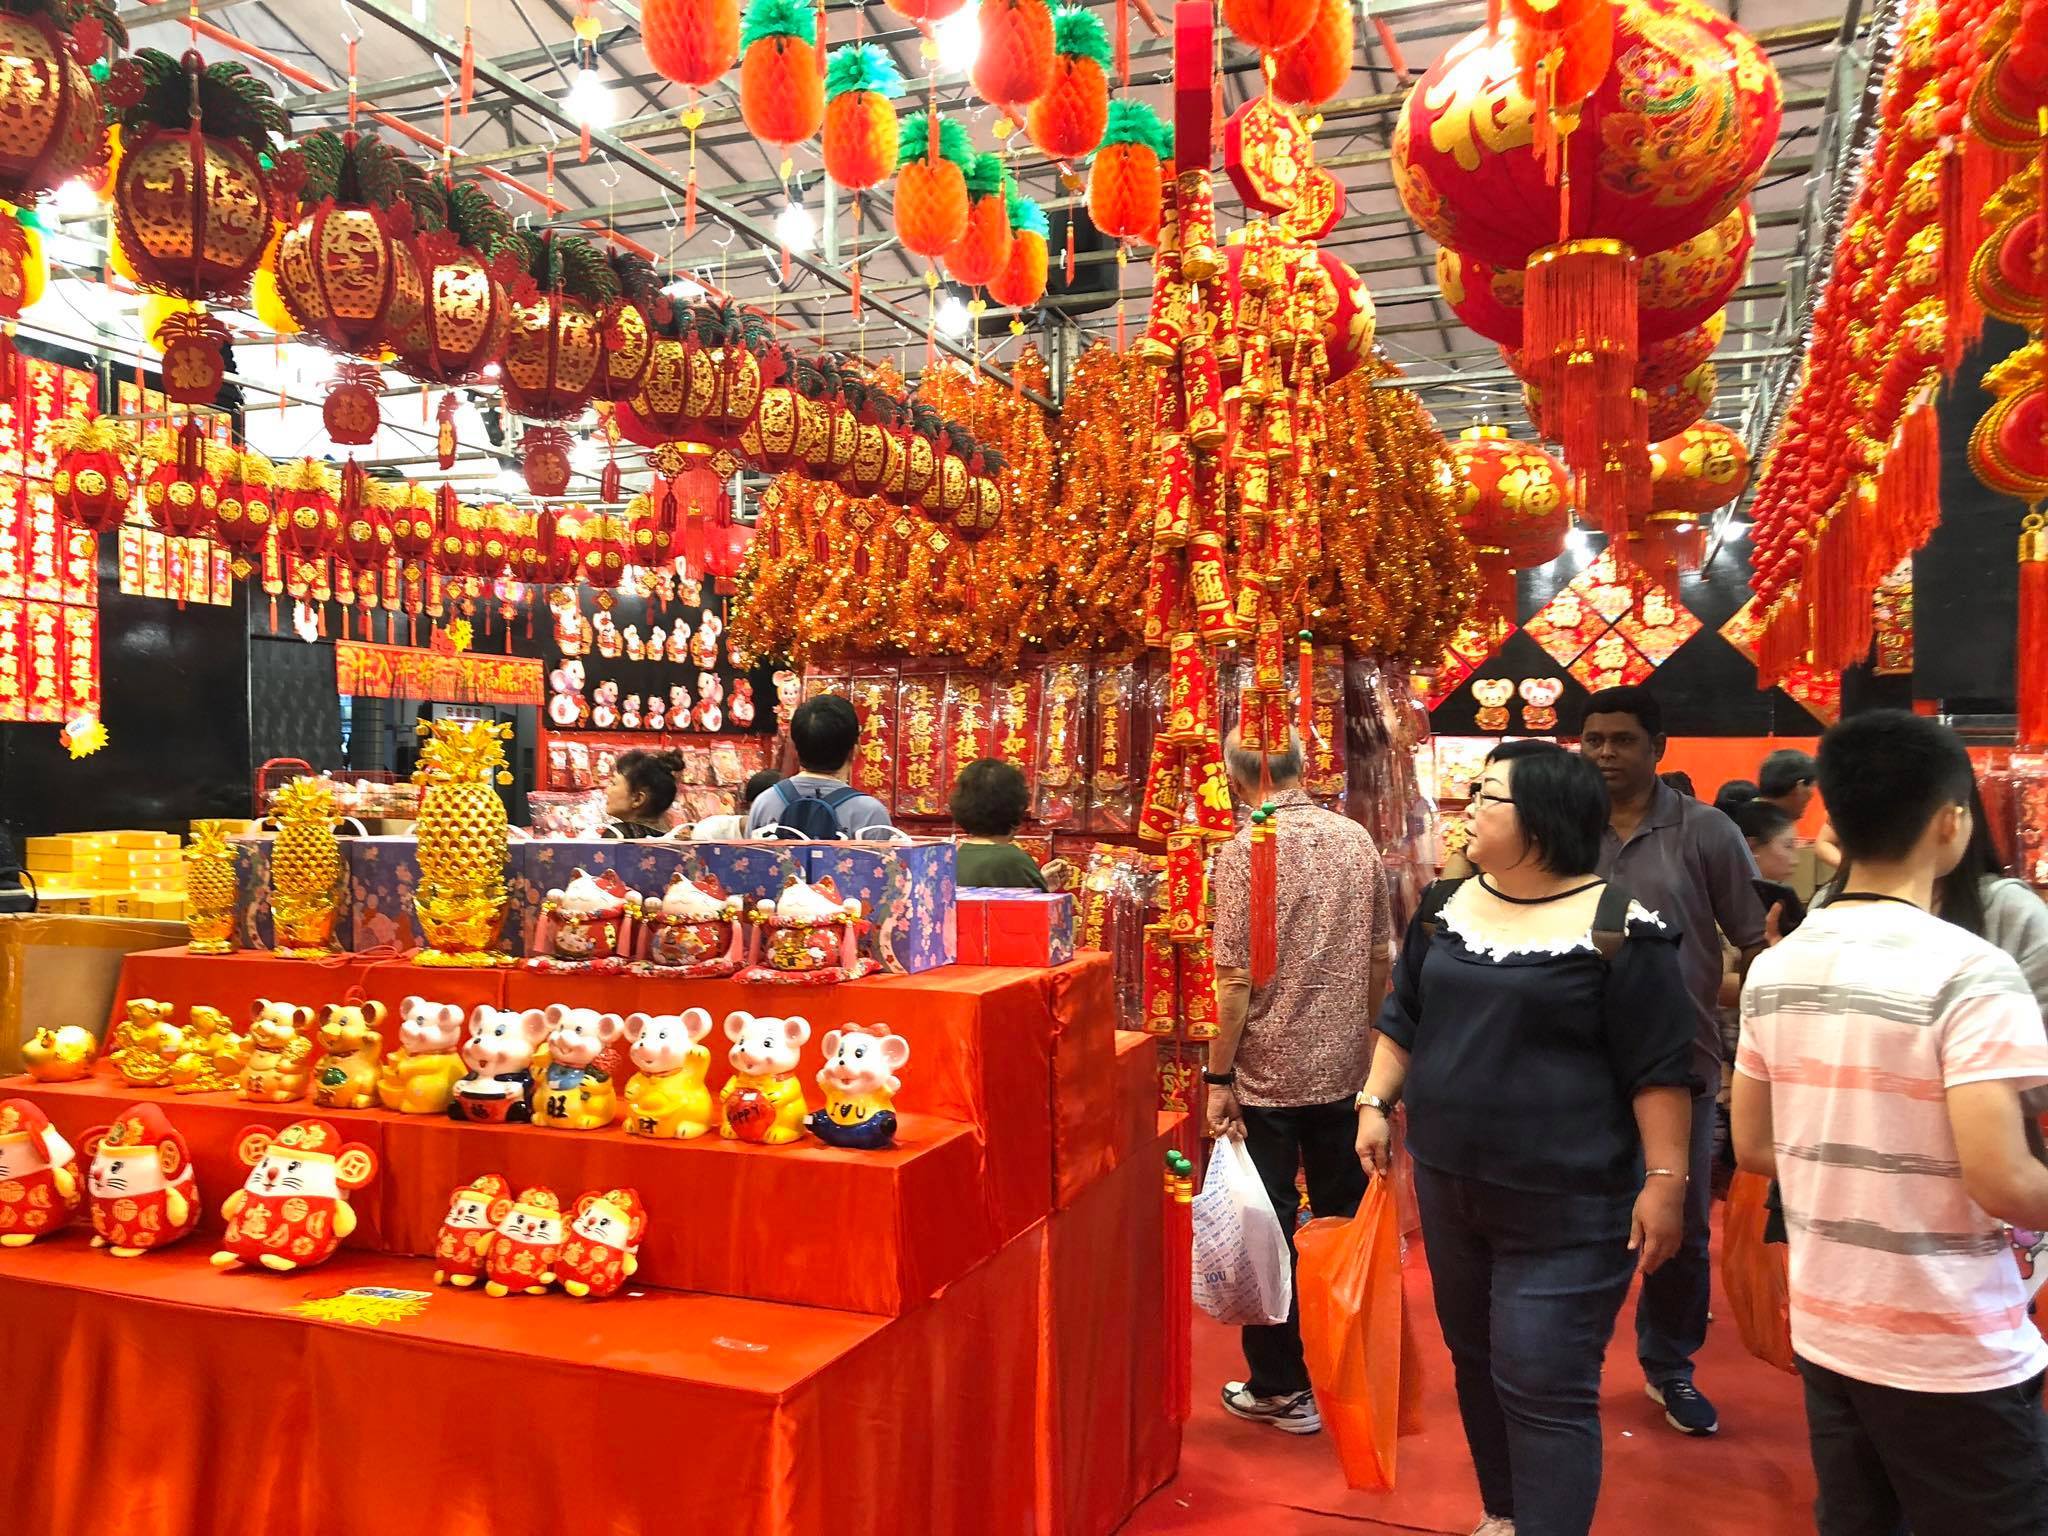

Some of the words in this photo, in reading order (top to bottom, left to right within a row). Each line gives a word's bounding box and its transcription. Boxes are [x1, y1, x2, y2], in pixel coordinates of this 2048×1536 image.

[1679, 430, 1741, 485] 福
[1497, 454, 1560, 516] 福
[855, 1105, 866, 1119] U
[1204, 1270, 1227, 1283] YOU
